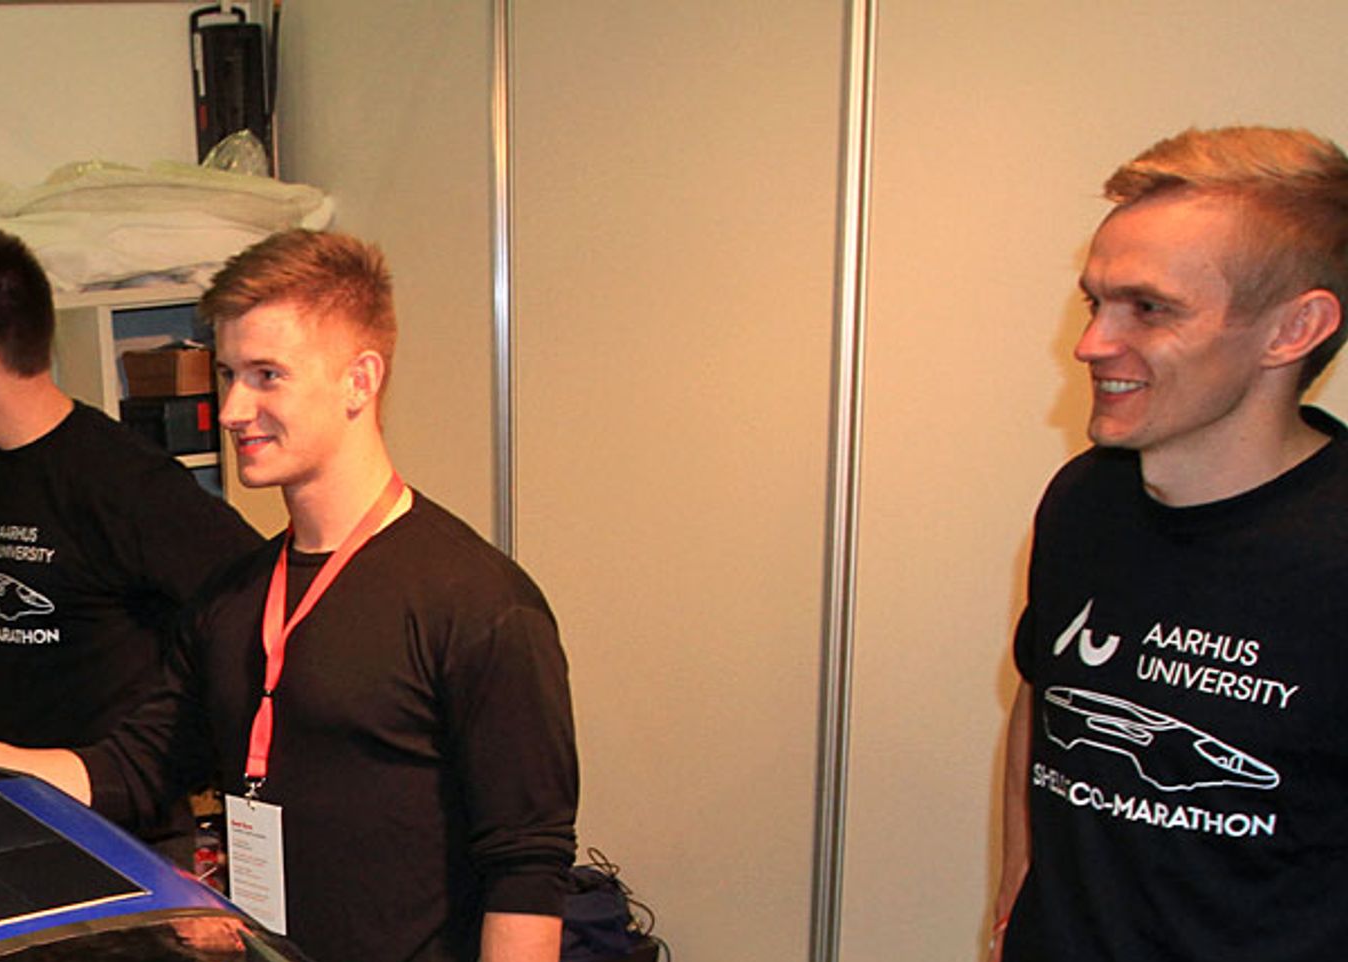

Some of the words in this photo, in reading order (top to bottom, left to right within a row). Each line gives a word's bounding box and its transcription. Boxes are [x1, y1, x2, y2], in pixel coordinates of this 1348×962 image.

[1142, 622, 1260, 667] AARHUS
[1136, 654, 1299, 709] UNIVERSITY
[1068, 781, 1277, 838] CO-MARATHON
